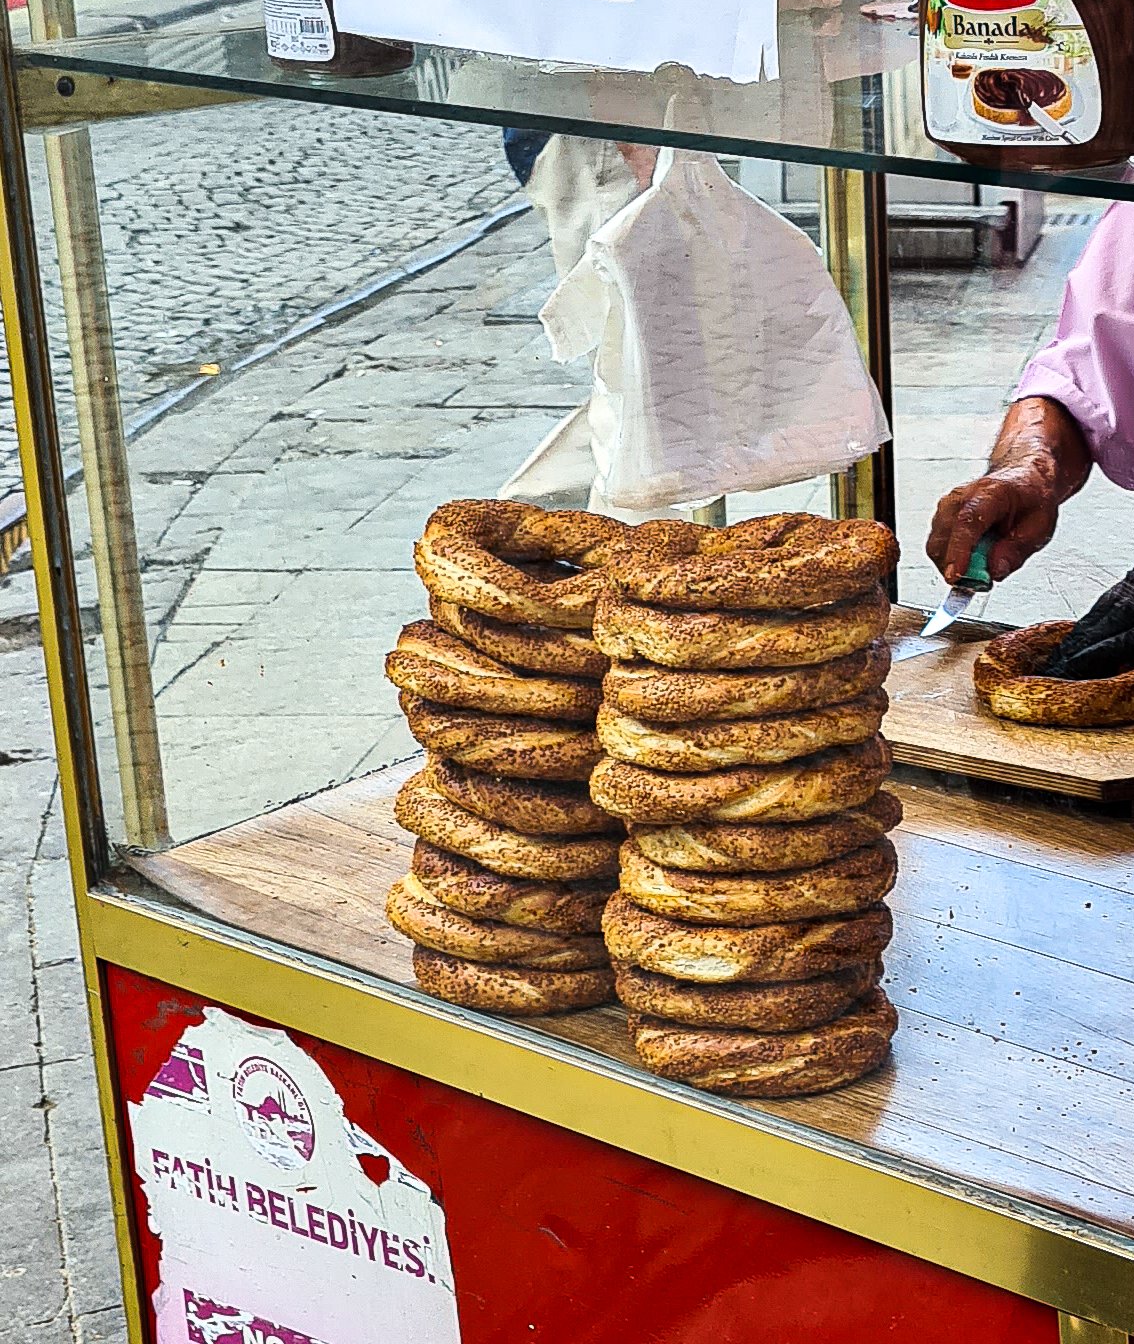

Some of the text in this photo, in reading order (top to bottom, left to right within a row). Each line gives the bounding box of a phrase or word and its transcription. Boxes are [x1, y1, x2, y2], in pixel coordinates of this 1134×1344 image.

[952, 14, 1034, 37] Banada
[152, 1148, 436, 1284] FATİH BELEDİYESİ
